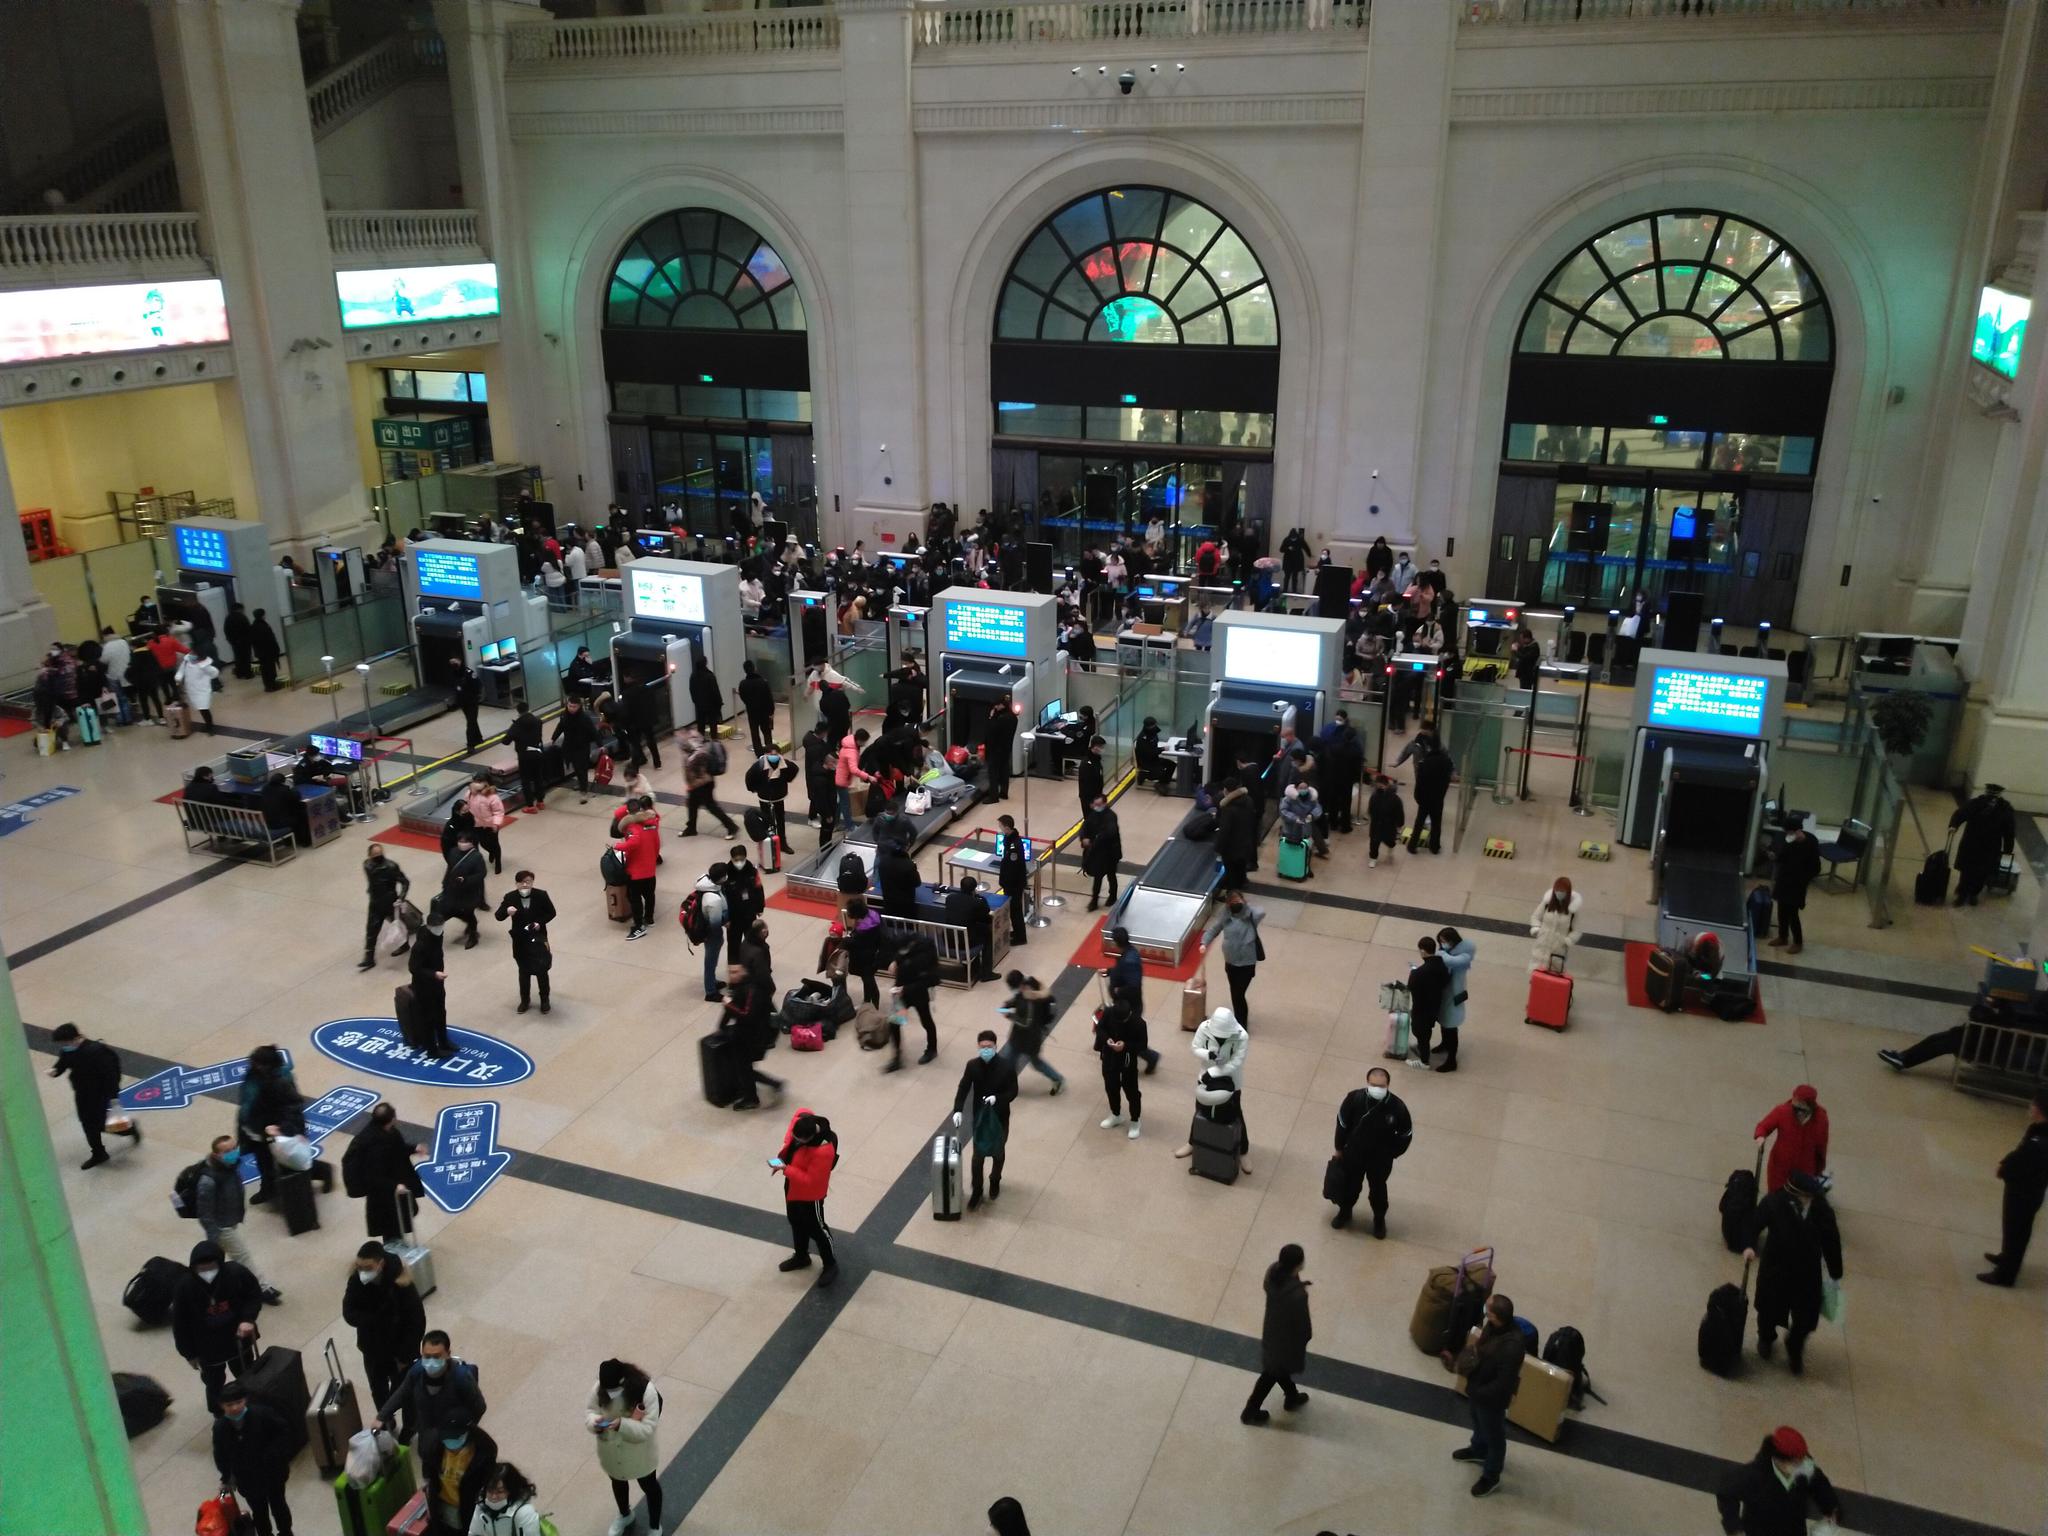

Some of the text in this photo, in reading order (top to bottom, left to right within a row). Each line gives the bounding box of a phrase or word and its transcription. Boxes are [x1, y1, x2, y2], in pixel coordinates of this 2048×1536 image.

[402, 425, 421, 437] 出口
[452, 421, 469, 433] 出口
[945, 662, 952, 671] 3
[1304, 701, 1312, 711] 2
[449, 1134, 480, 1145] 卫生间
